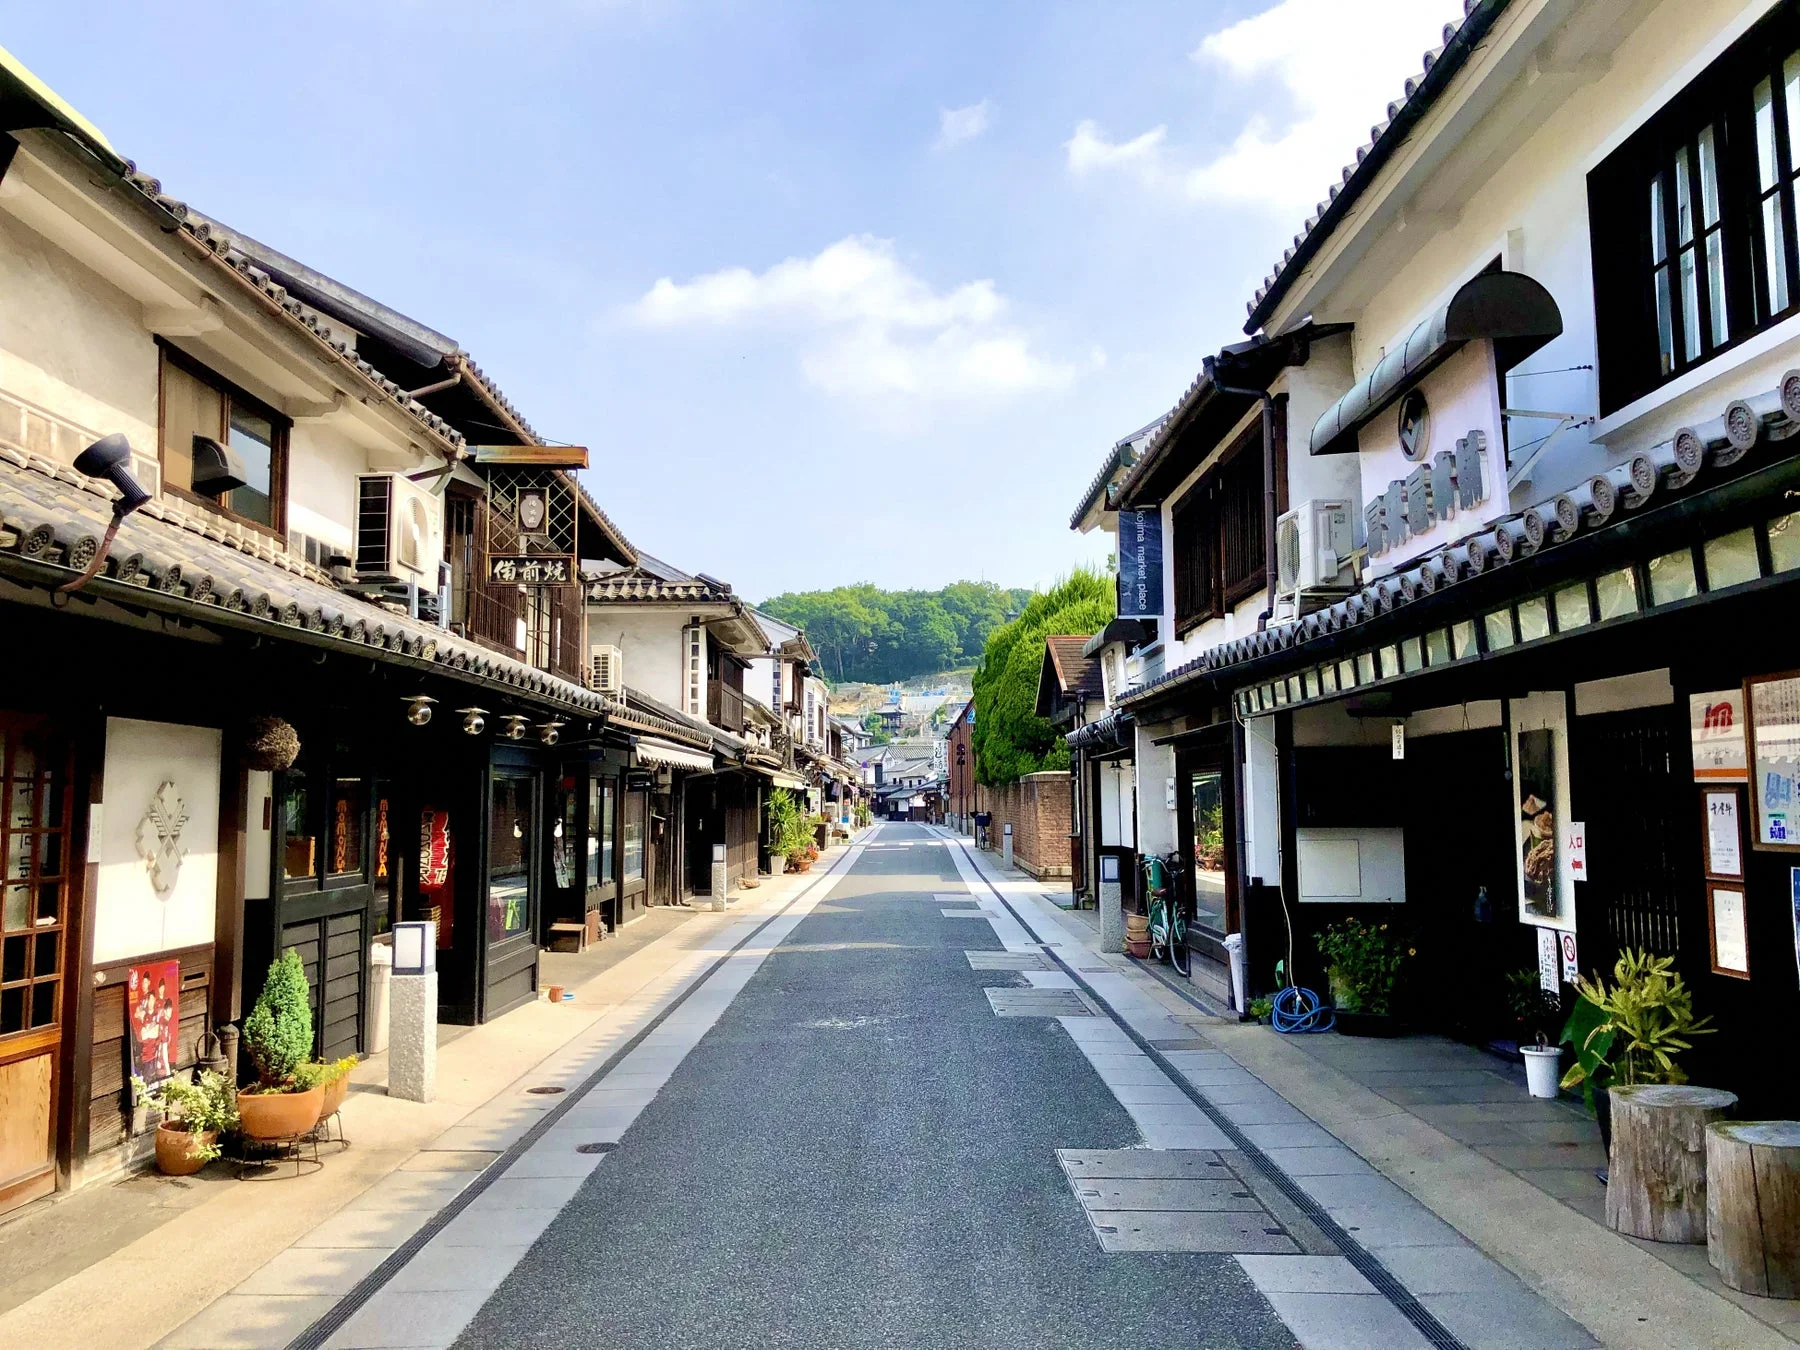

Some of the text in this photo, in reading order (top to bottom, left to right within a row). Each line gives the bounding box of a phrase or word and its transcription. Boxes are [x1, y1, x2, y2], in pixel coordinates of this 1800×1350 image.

[493, 559, 567, 582] 備前焼
[1135, 510, 1147, 610] kojima market place
[378, 799, 388, 877] MOMONGA
[1569, 835, 1583, 849] 入口
